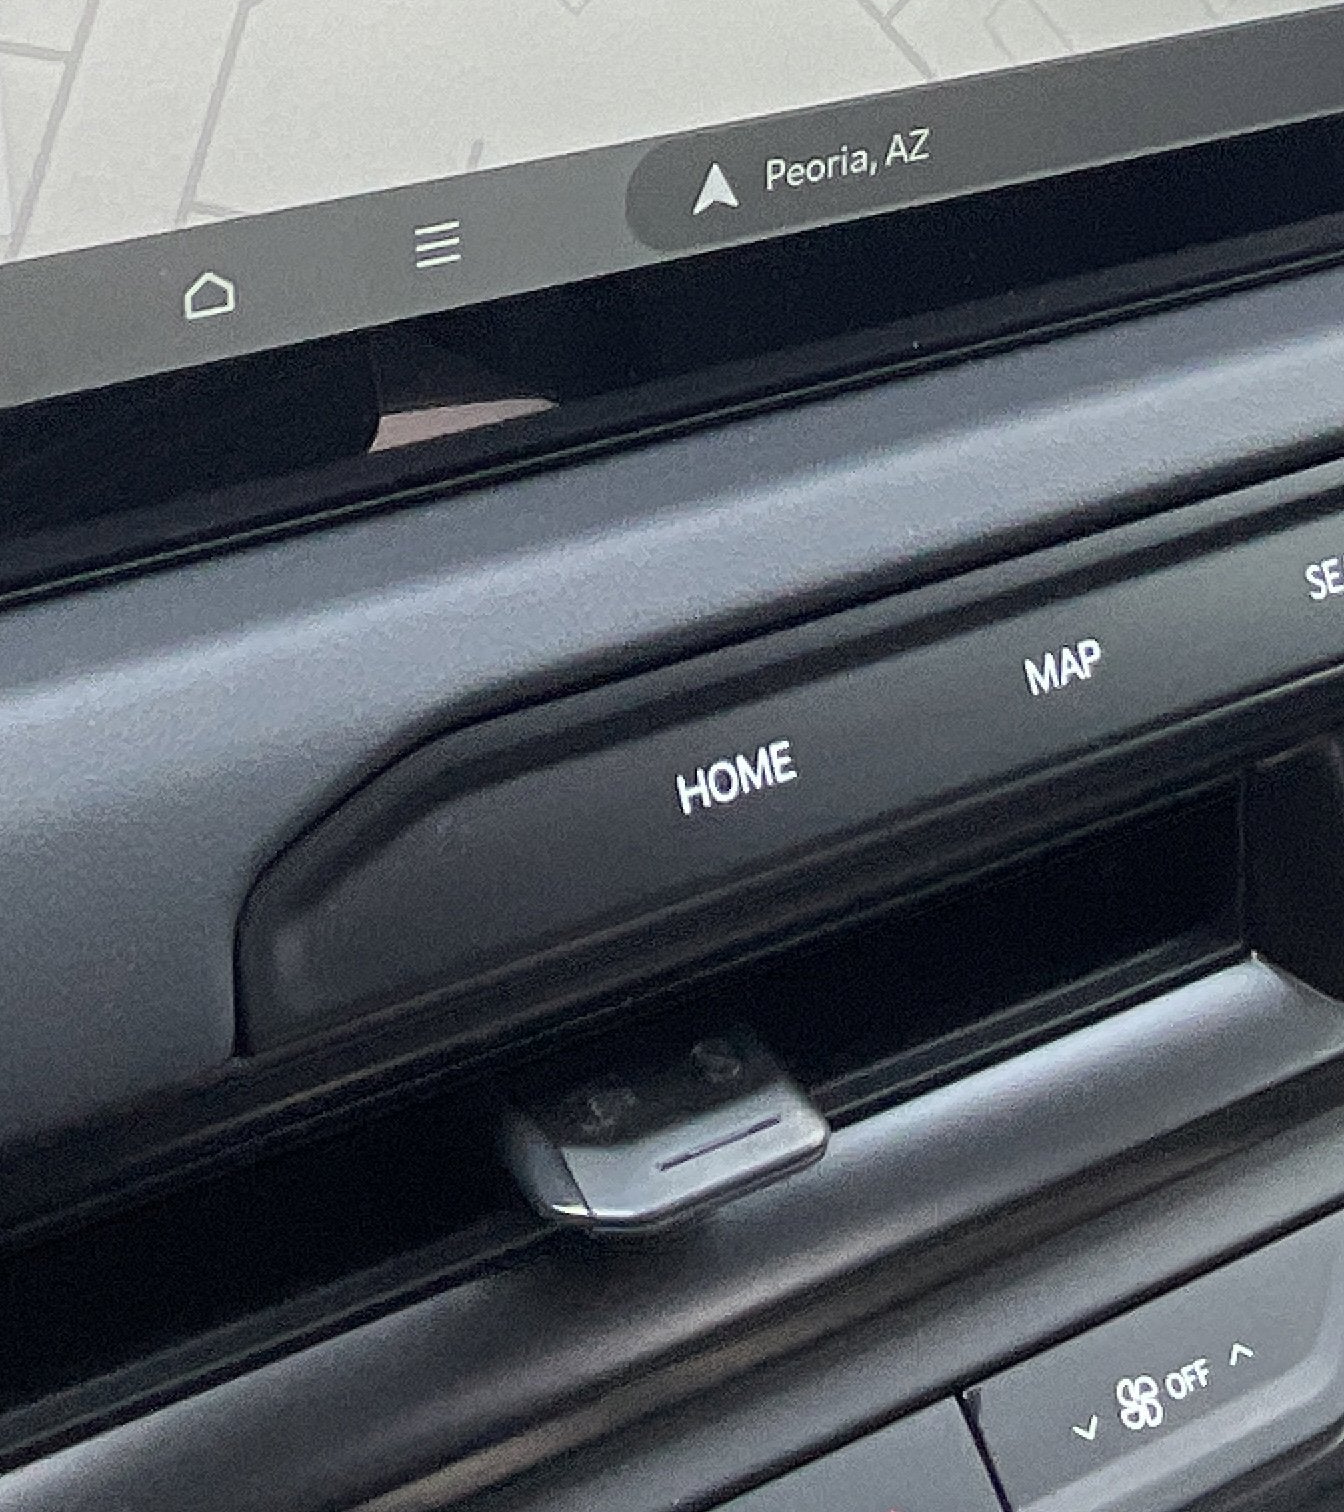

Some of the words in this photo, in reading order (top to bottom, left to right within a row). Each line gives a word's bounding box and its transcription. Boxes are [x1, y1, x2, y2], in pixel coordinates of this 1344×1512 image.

[765, 144, 878, 191] Peoria,
[885, 127, 931, 167] AZ
[1024, 638, 1103, 697] MAP
[675, 740, 798, 816] HOME
[1164, 1357, 1210, 1400] OFF
